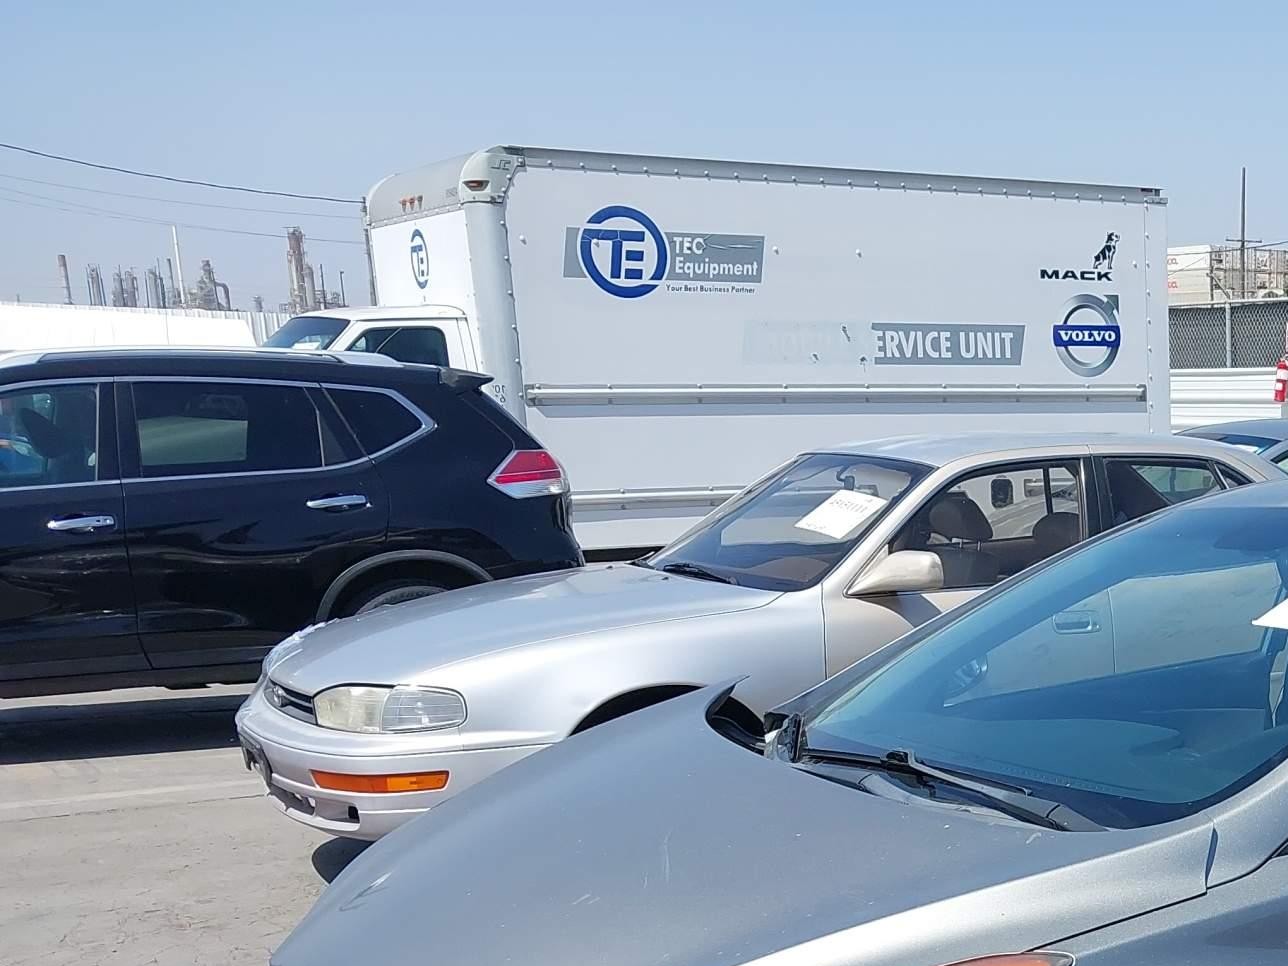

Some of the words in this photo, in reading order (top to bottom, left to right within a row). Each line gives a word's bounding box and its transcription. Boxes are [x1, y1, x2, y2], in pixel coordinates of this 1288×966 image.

[673, 236, 705, 255] TEC
[675, 257, 758, 278] Equipment
[1040, 269, 1113, 282] MACK
[666, 284, 681, 292] Your
[684, 284, 698, 293] Best
[700, 285, 730, 293] Business
[731, 286, 756, 294] Partner
[1057, 330, 1116, 342] VOLVO
[959, 331, 1014, 359] UNIT
